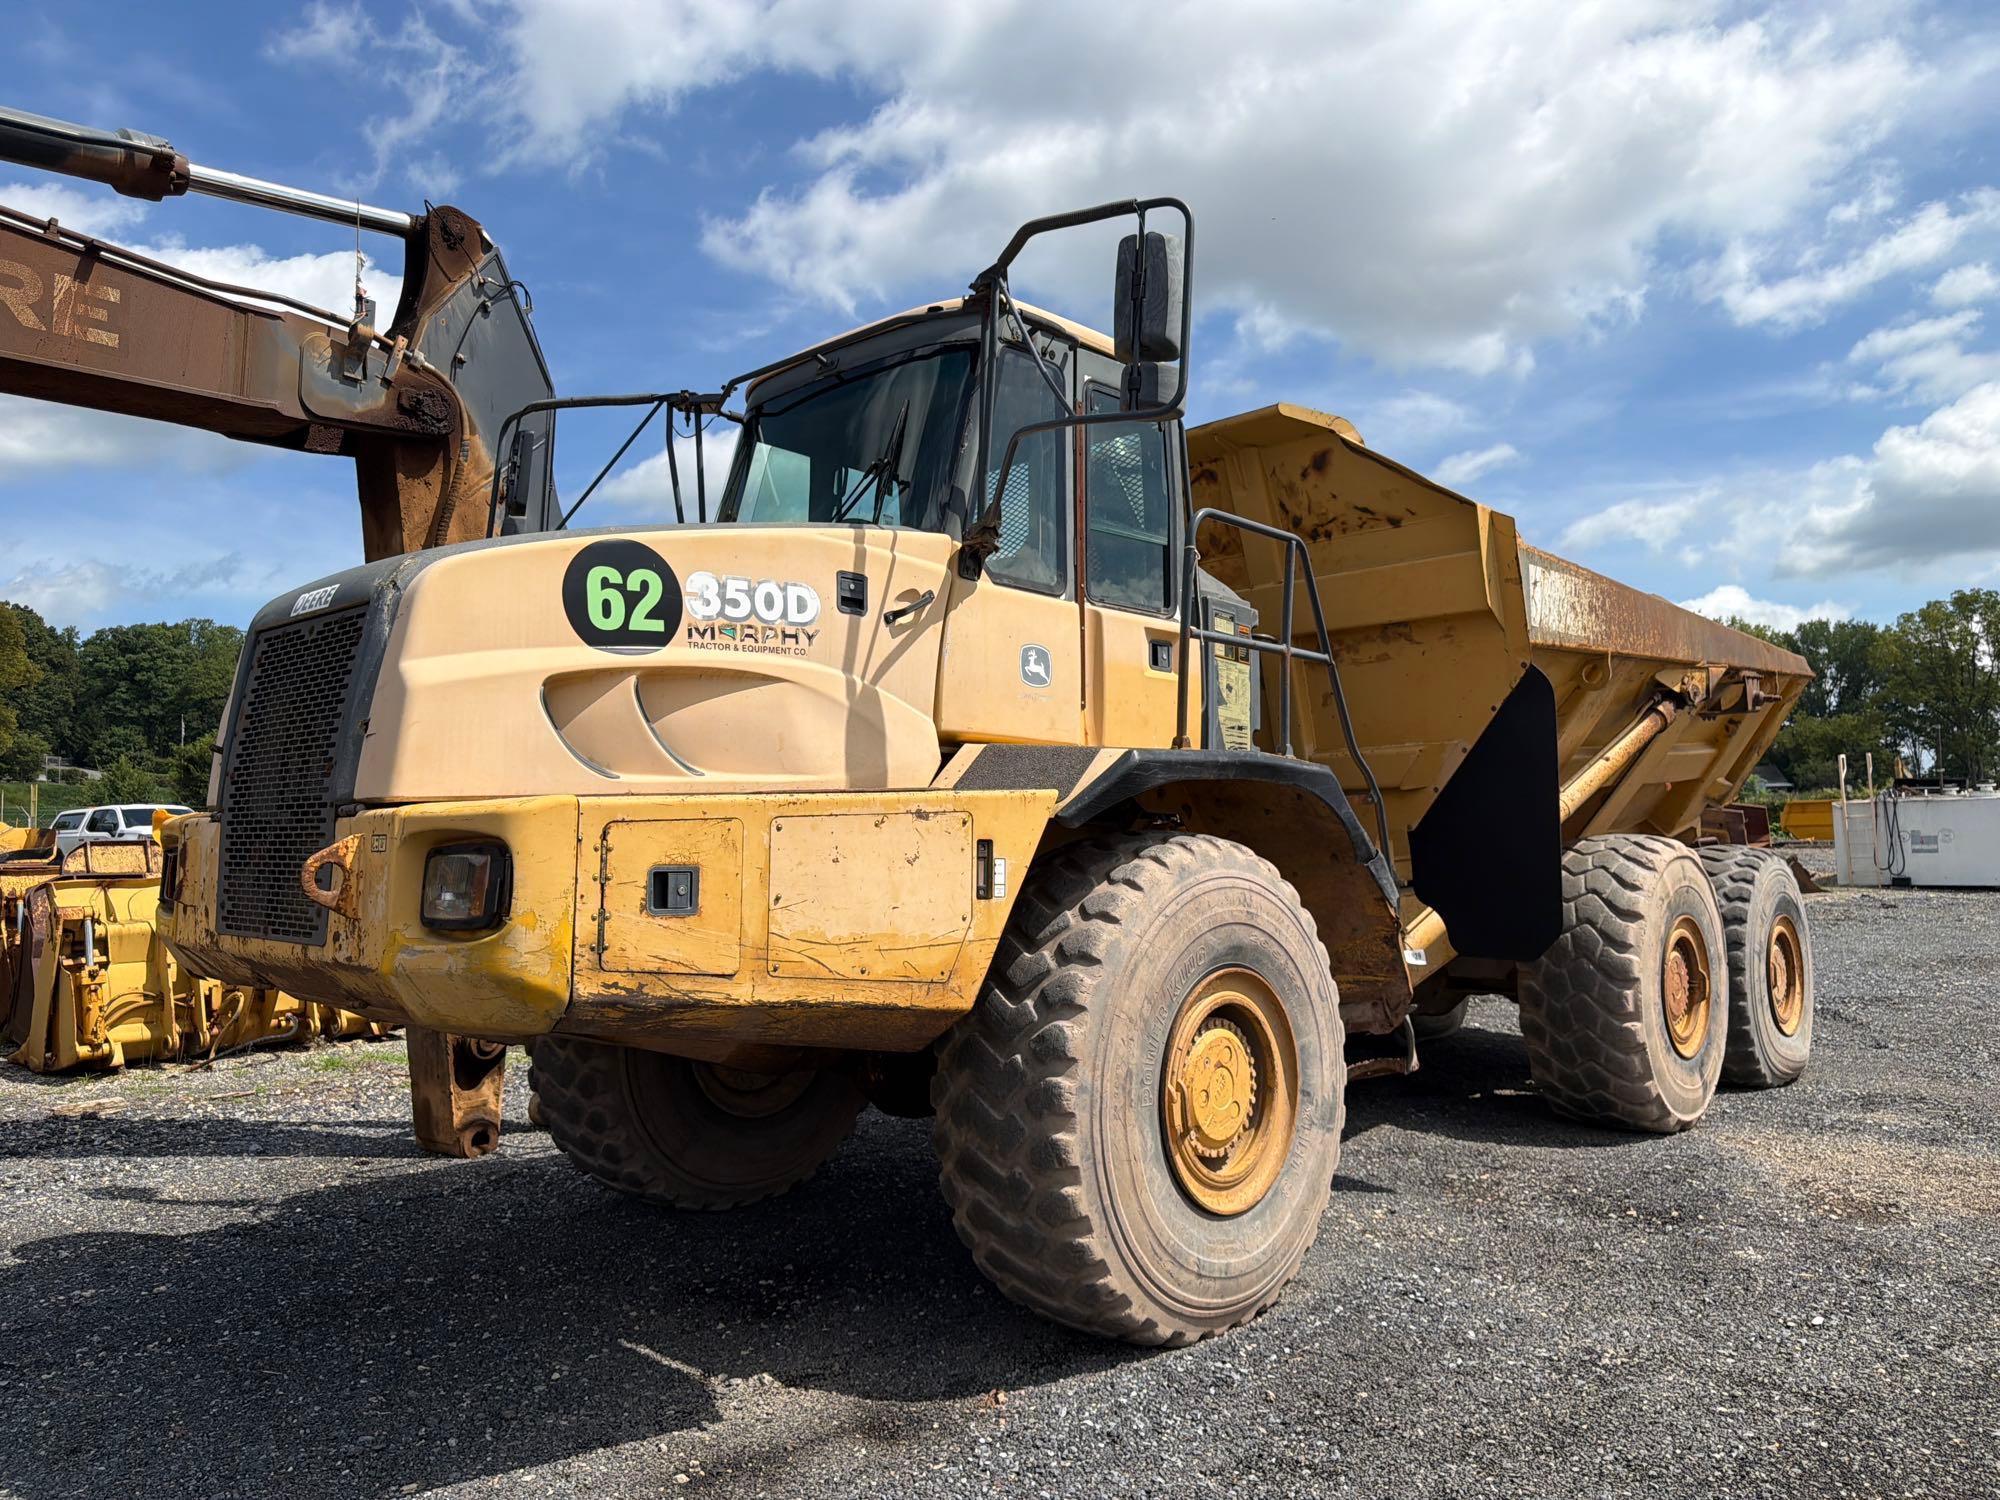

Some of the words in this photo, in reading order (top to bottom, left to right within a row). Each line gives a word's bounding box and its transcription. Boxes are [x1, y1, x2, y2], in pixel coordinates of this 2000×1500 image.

[291, 585, 339, 616] DEERE
[587, 566, 665, 632] 62
[685, 571, 820, 625] 350D
[688, 641, 731, 652] TRACTOR
[733, 644, 739, 652] &
[742, 644, 792, 655] EQUIPMENT
[1166, 946, 1208, 1002] KING
